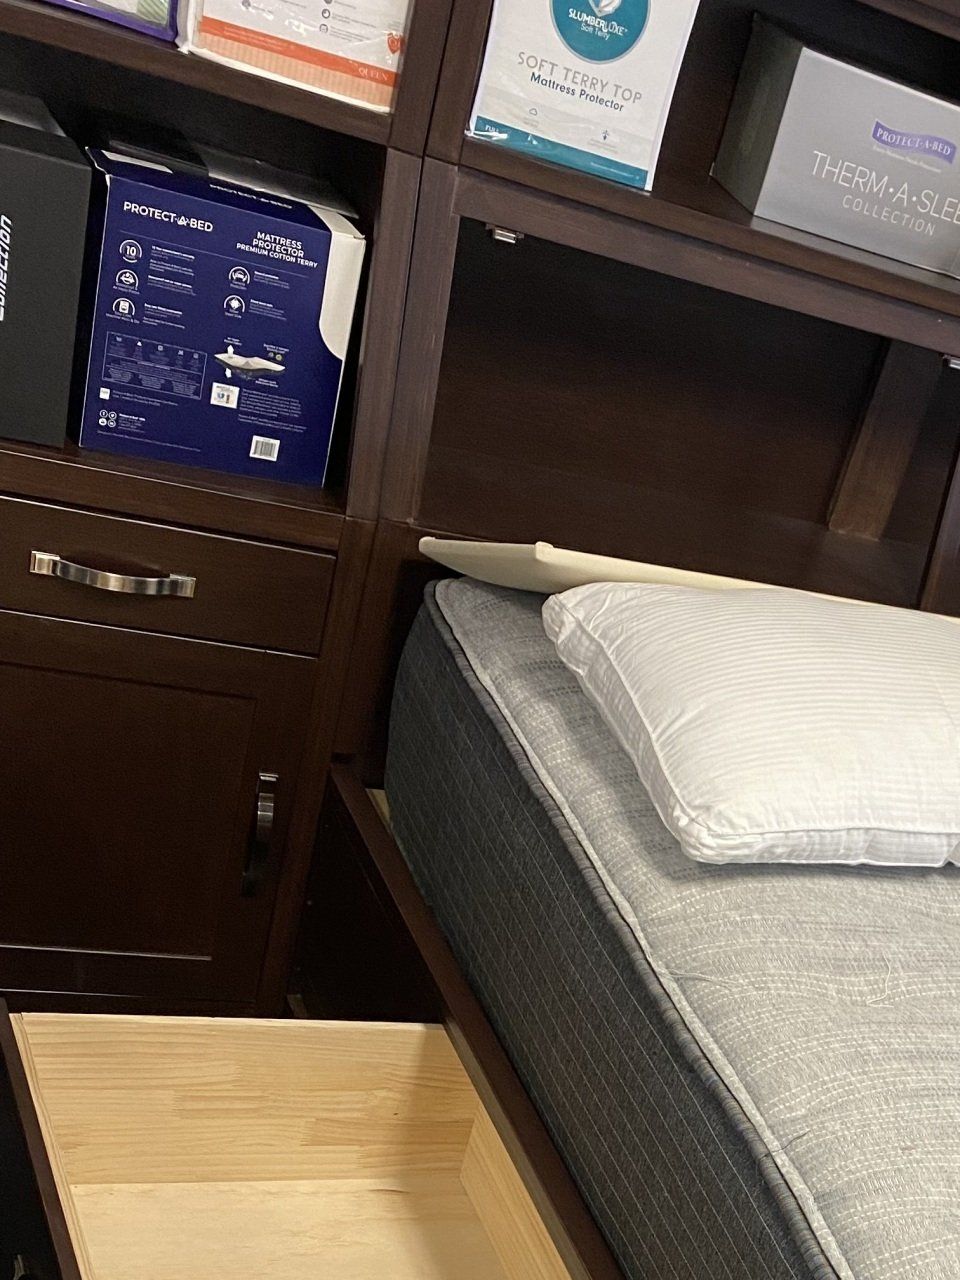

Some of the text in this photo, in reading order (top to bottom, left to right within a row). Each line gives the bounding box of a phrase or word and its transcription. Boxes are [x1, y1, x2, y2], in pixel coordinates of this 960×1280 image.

[517, 51, 643, 104] SOFT TERRY TOP
[530, 72, 624, 112] Mattress Protector
[842, 195, 936, 236] COLLECTION
[126, 245, 137, 256] 10
[253, 238, 304, 258] PROTECTOR
[257, 231, 302, 249] MATTRESS
[236, 243, 318, 268] PREMIUM COTTON TERRY
